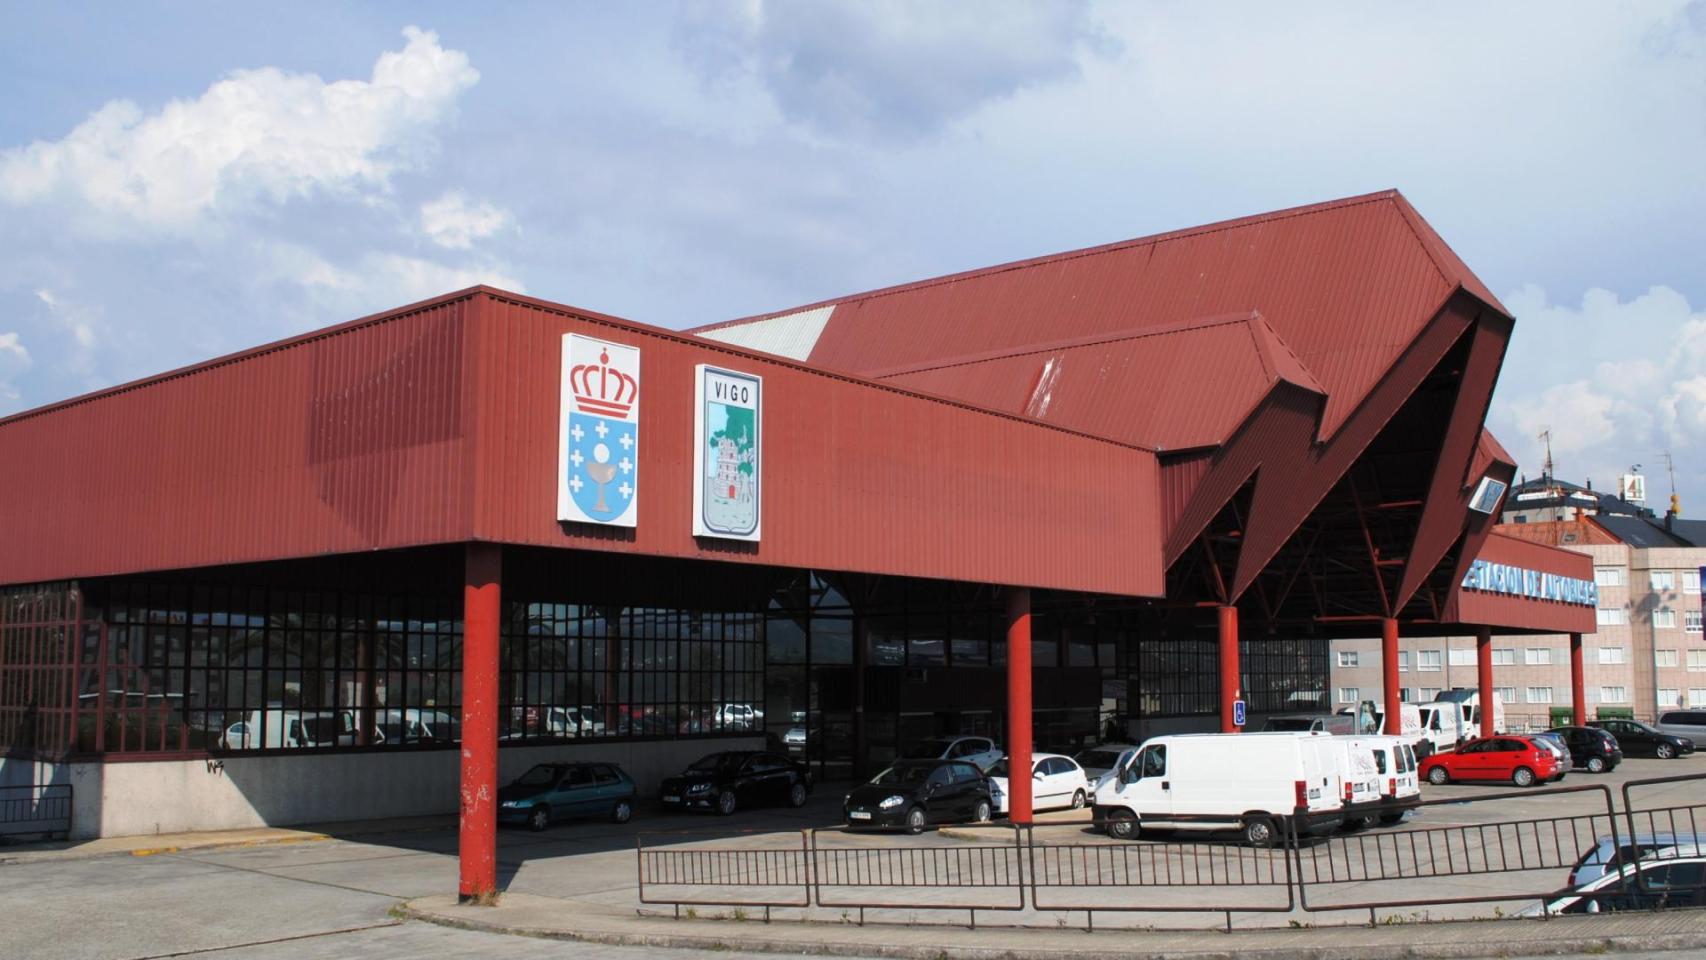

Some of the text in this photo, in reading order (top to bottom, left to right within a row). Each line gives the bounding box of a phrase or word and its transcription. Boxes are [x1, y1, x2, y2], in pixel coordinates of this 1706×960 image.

[715, 381, 748, 404] VIGO
[1523, 569, 1541, 599] DE
[1542, 573, 1598, 606] AUTOBUSES
